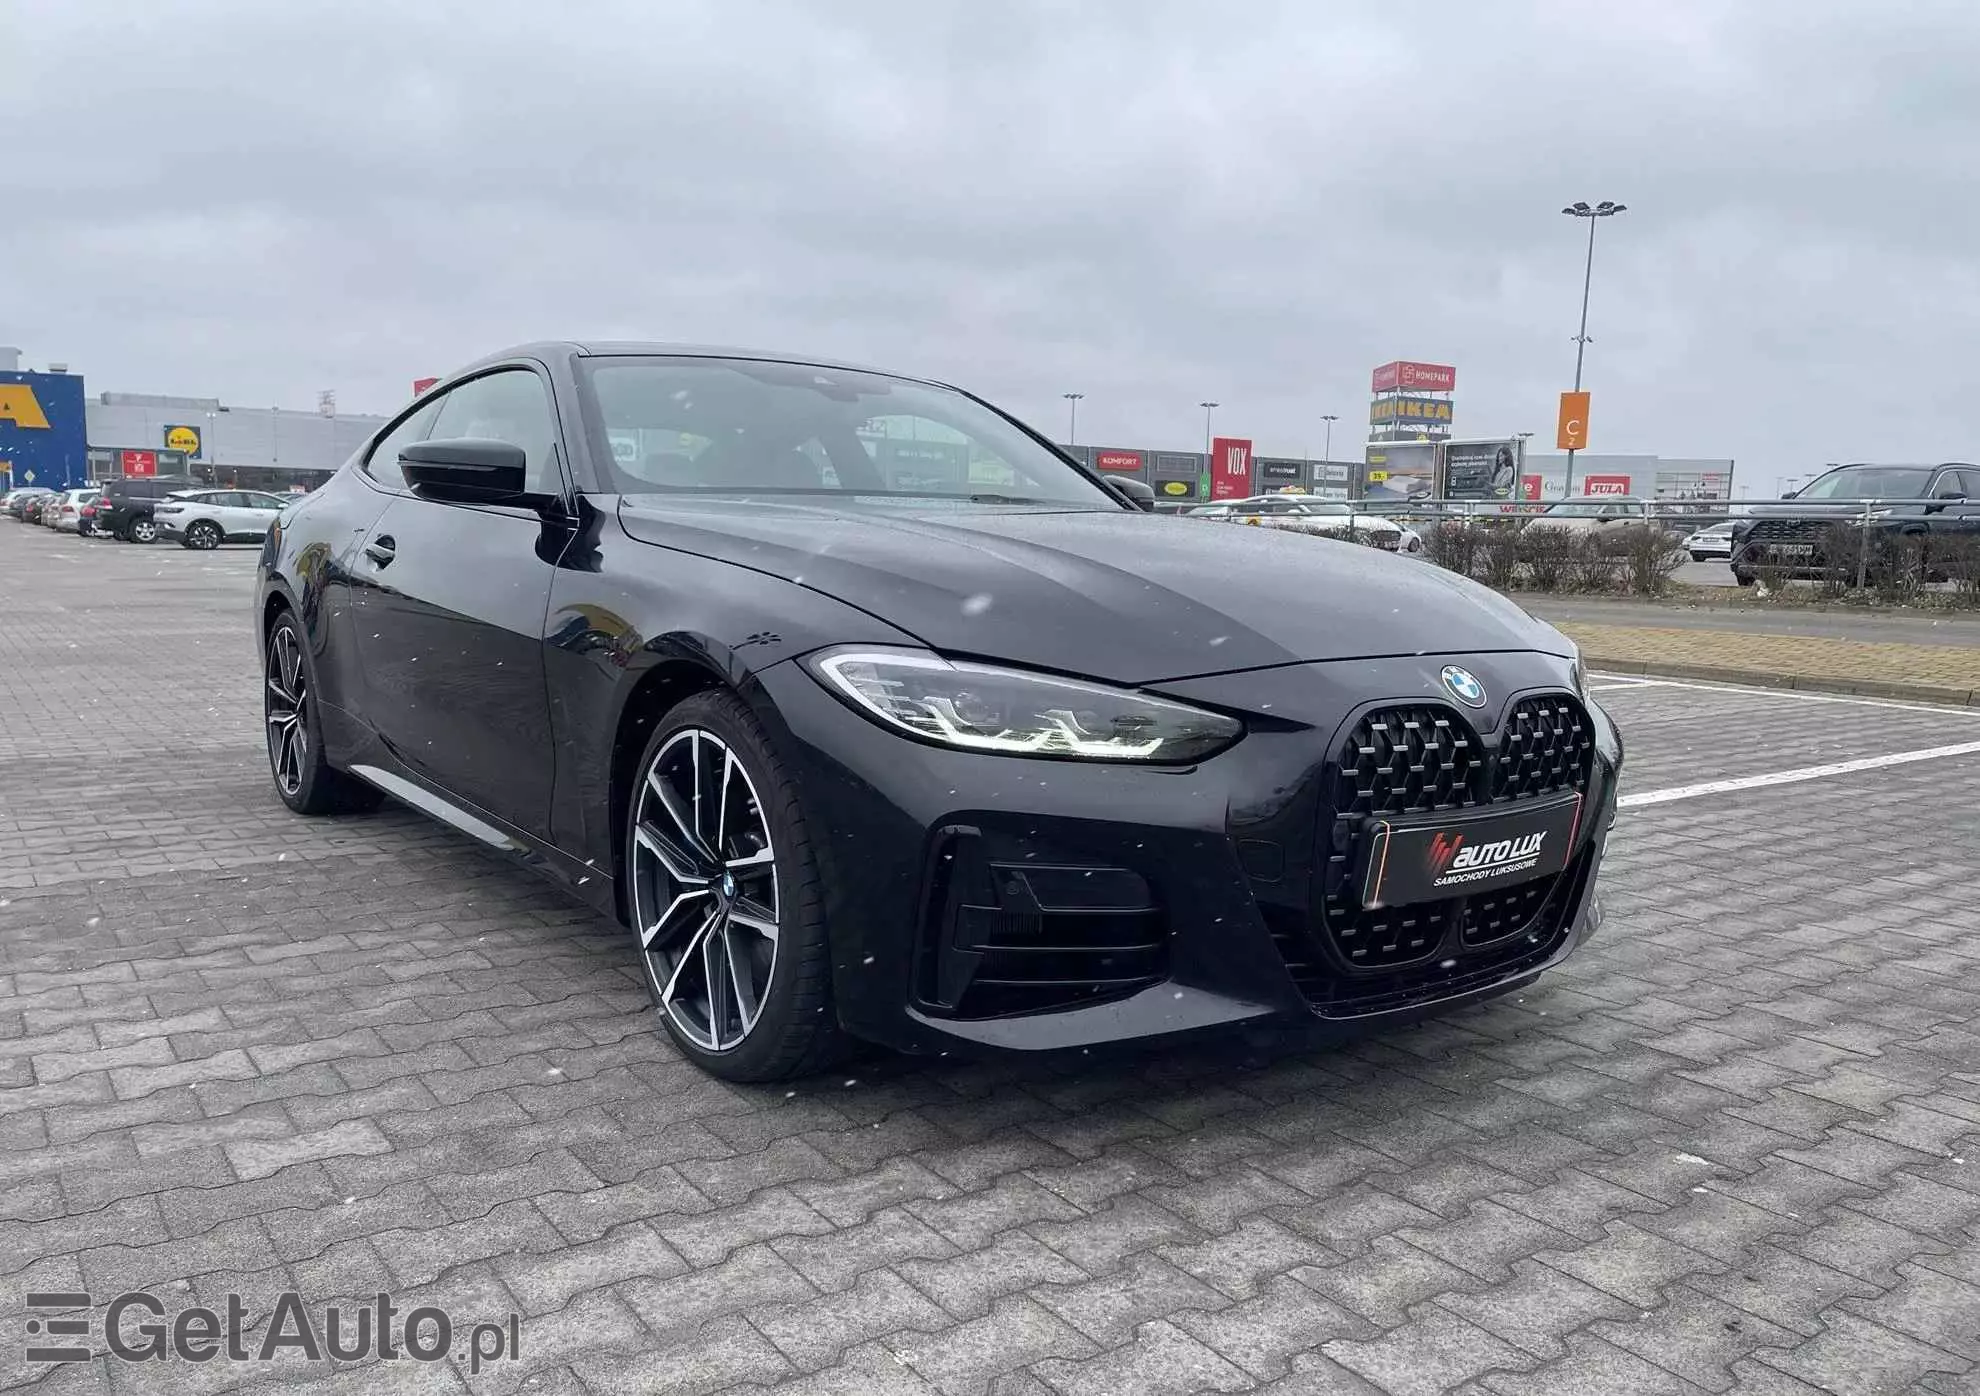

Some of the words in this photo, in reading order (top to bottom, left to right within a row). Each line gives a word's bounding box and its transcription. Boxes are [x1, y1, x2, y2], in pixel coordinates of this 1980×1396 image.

[1415, 370, 1450, 383] HOMEPARK
[1396, 400, 1450, 419] IKEA
[1566, 420, 1579, 436] C
[1102, 456, 1137, 465] KOMFORT
[1227, 447, 1248, 475] VOX
[1591, 484, 1625, 495] JULA
[1509, 830, 1548, 858] LUX
[1433, 870, 1491, 886] SAMOCHODY
[1490, 858, 1538, 877] LUKSUSOWE
